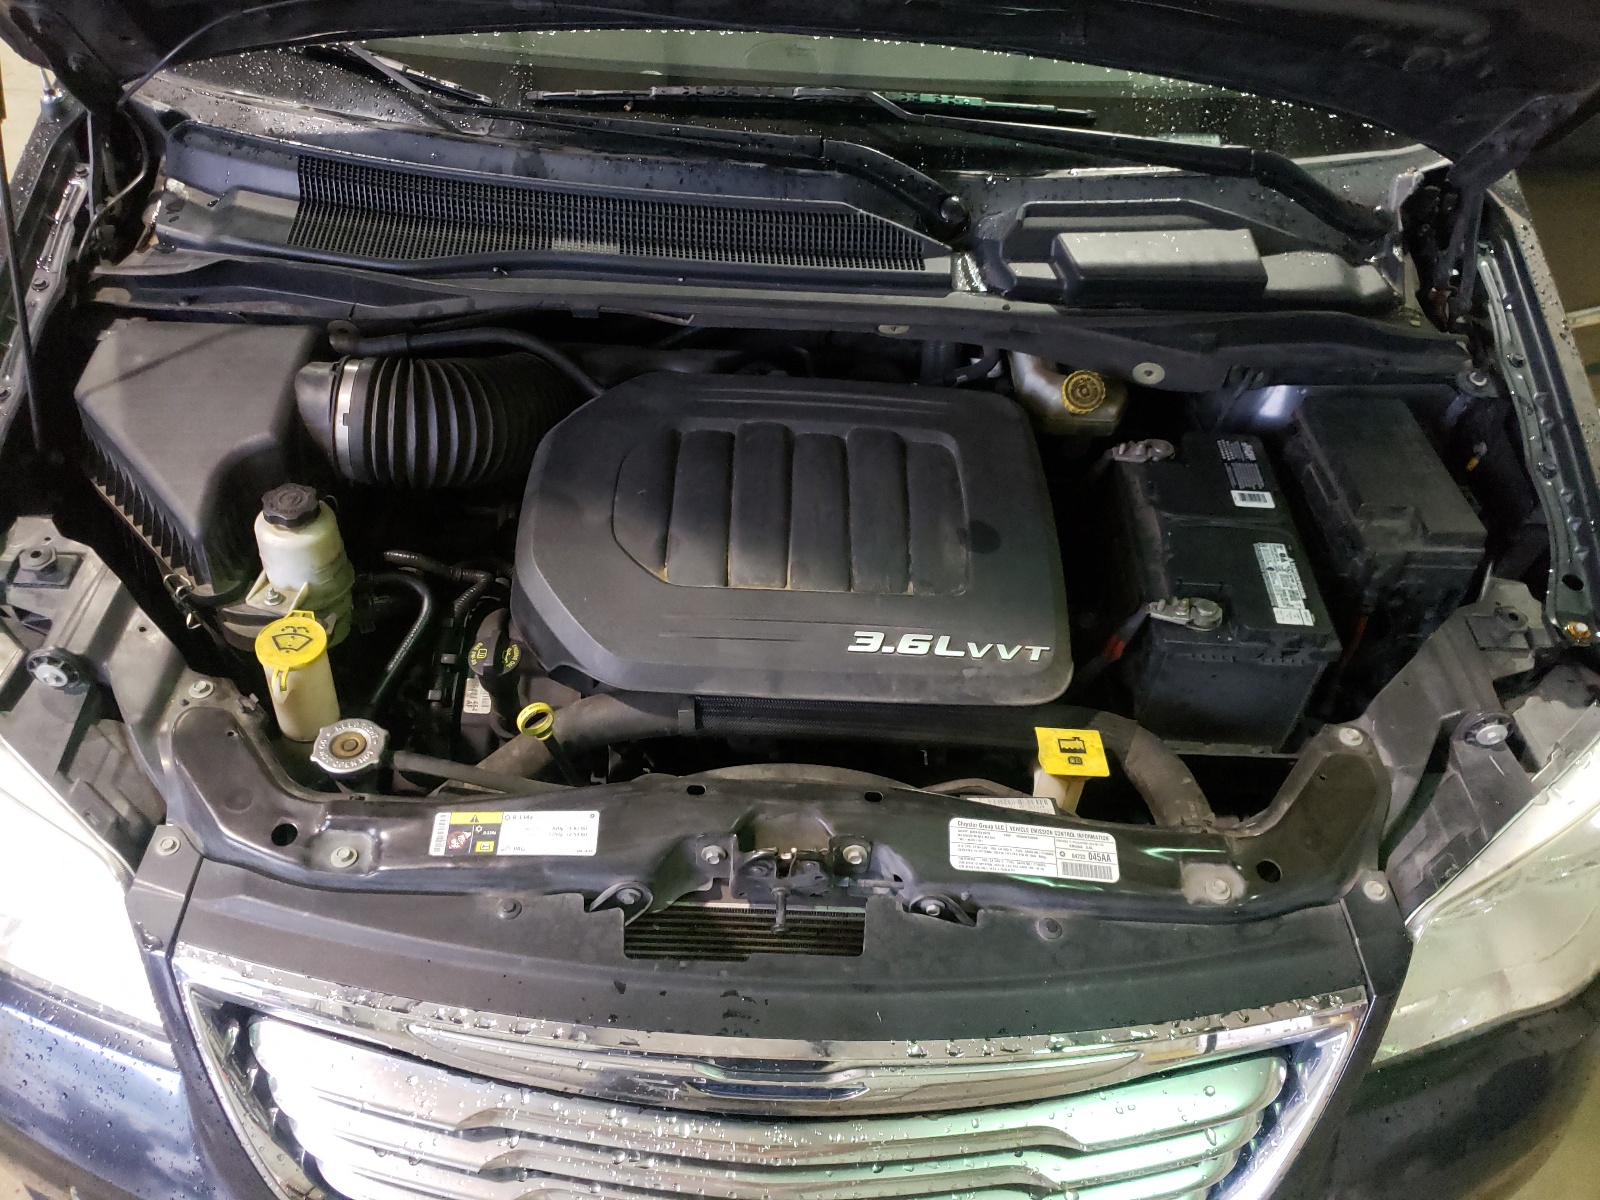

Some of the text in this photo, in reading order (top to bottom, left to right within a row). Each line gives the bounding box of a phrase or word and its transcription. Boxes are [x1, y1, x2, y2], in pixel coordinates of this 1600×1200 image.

[957, 820, 1005, 831] Chrysler Group LLC
[1009, 825, 1110, 842] VEHICLE EMISSION CONTROL INFORMATION
[1088, 852, 1112, 863] 045AA
